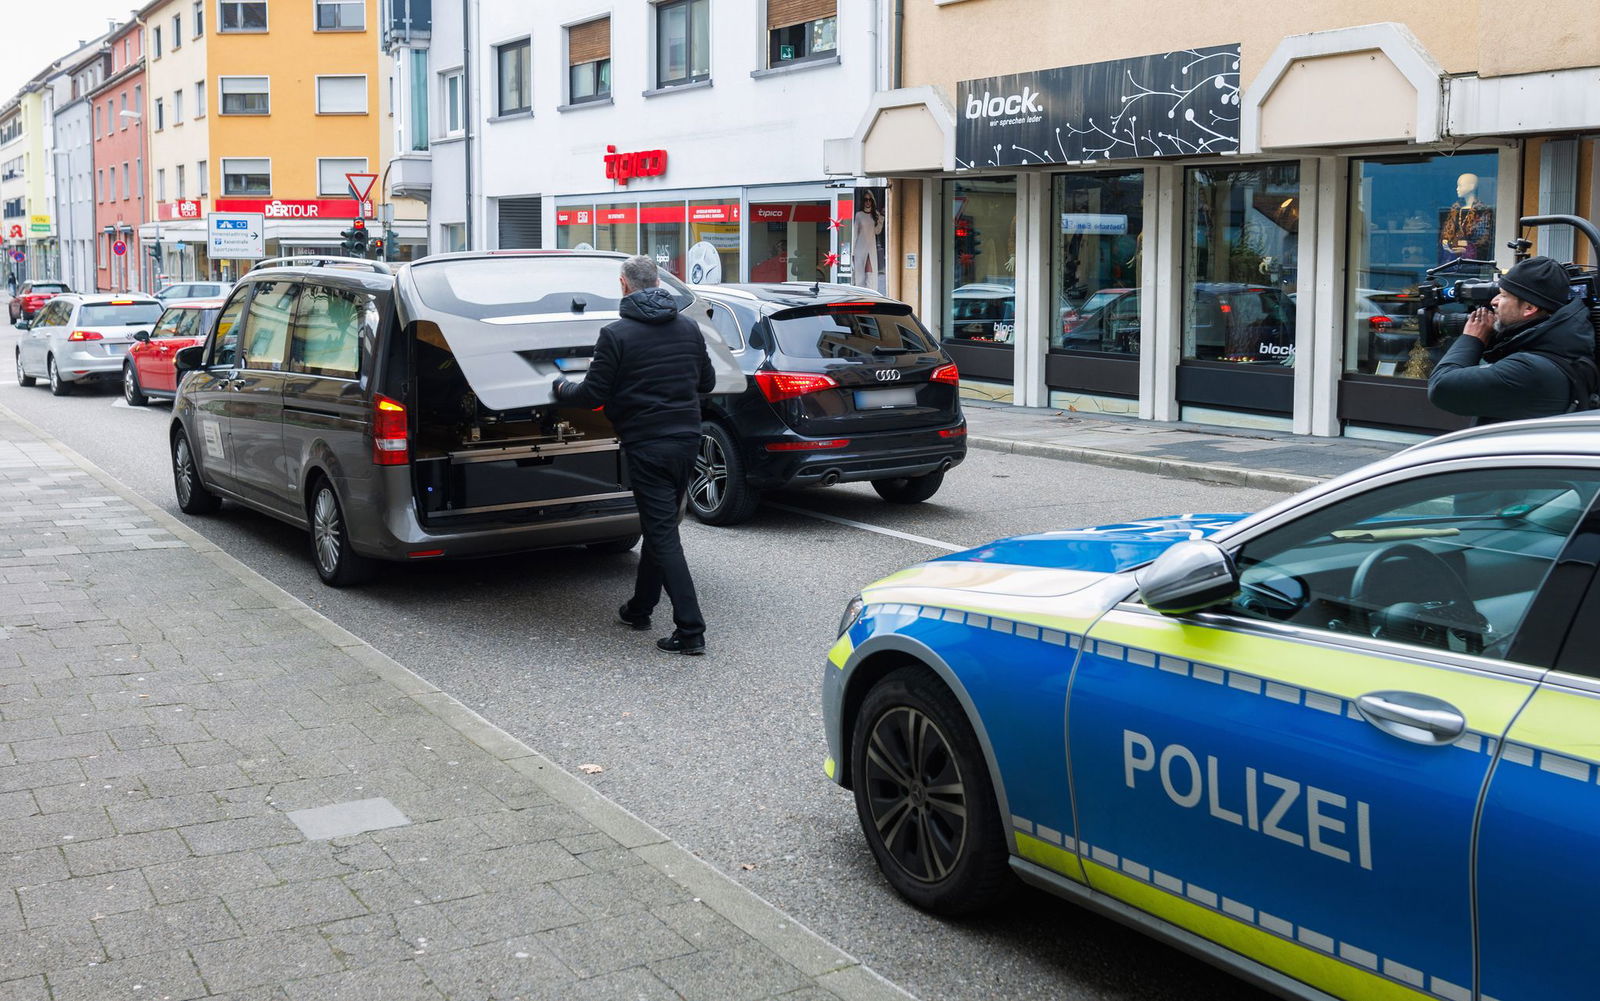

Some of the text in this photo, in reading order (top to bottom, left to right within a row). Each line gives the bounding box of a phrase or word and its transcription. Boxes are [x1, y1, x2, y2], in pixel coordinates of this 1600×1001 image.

[966, 86, 1043, 119] block.
[990, 115, 1042, 127] wir sprechen leder
[604, 145, 667, 185] tipico
[181, 202, 197, 211] DER
[265, 202, 318, 217] DERTOUR
[757, 208, 783, 217] tipico
[994, 322, 1015, 332] bloc
[1124, 729, 1373, 871] POLIZEI
